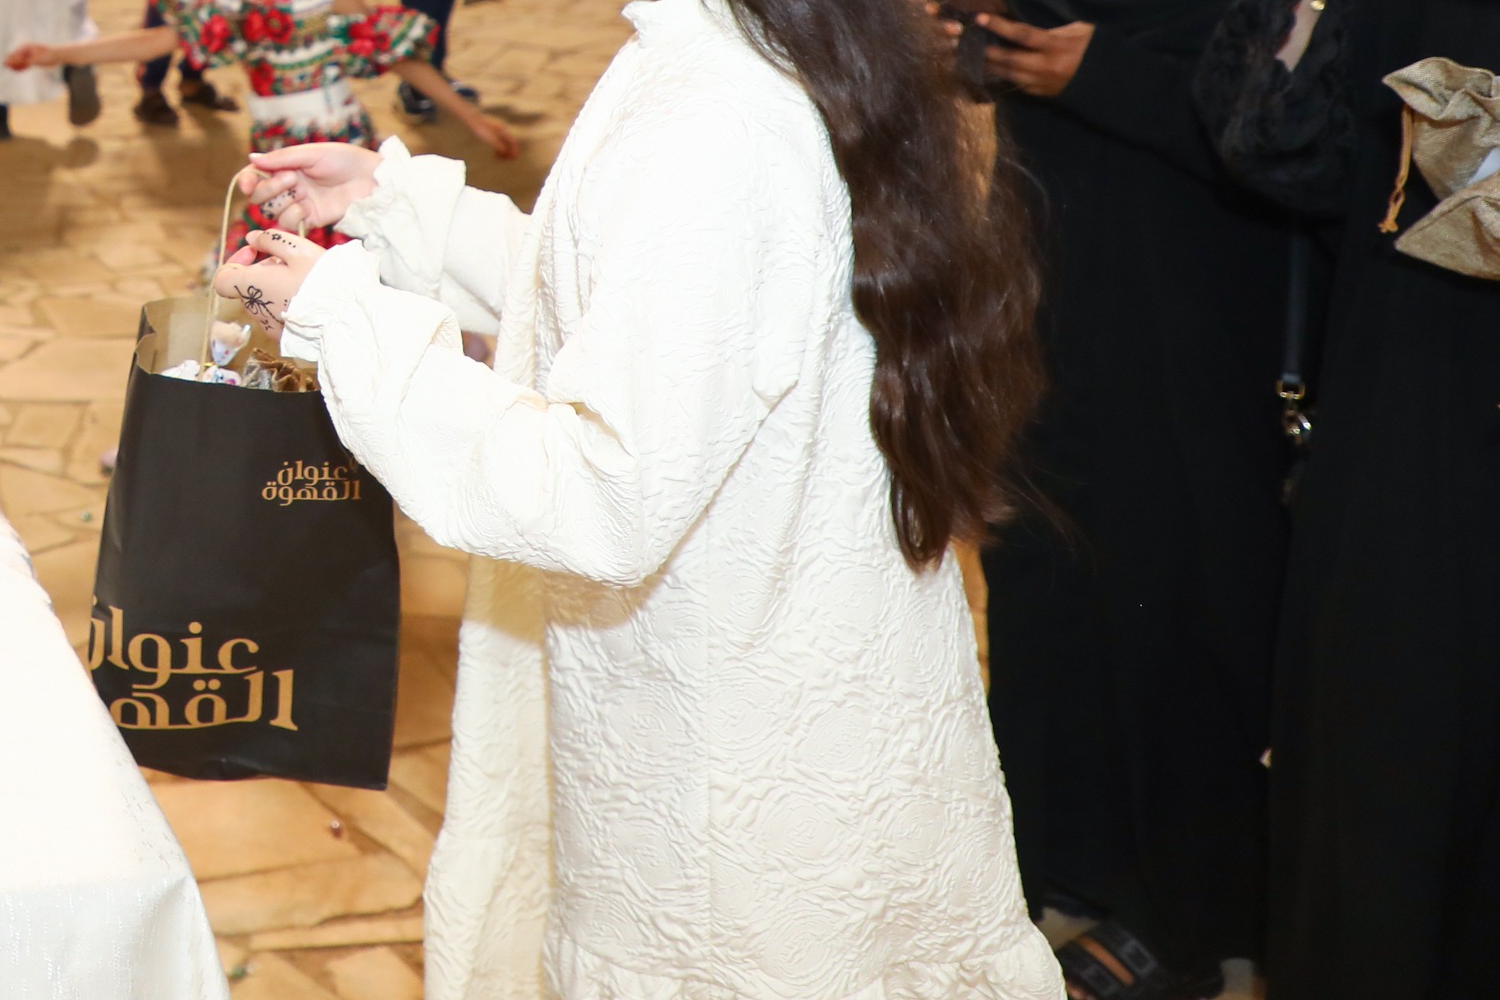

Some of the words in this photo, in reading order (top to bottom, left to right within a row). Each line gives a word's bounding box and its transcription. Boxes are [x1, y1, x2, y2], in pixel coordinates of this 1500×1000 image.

[278, 459, 348, 486] عنوان
[262, 480, 361, 506] القهوة
[109, 669, 299, 731] القه
